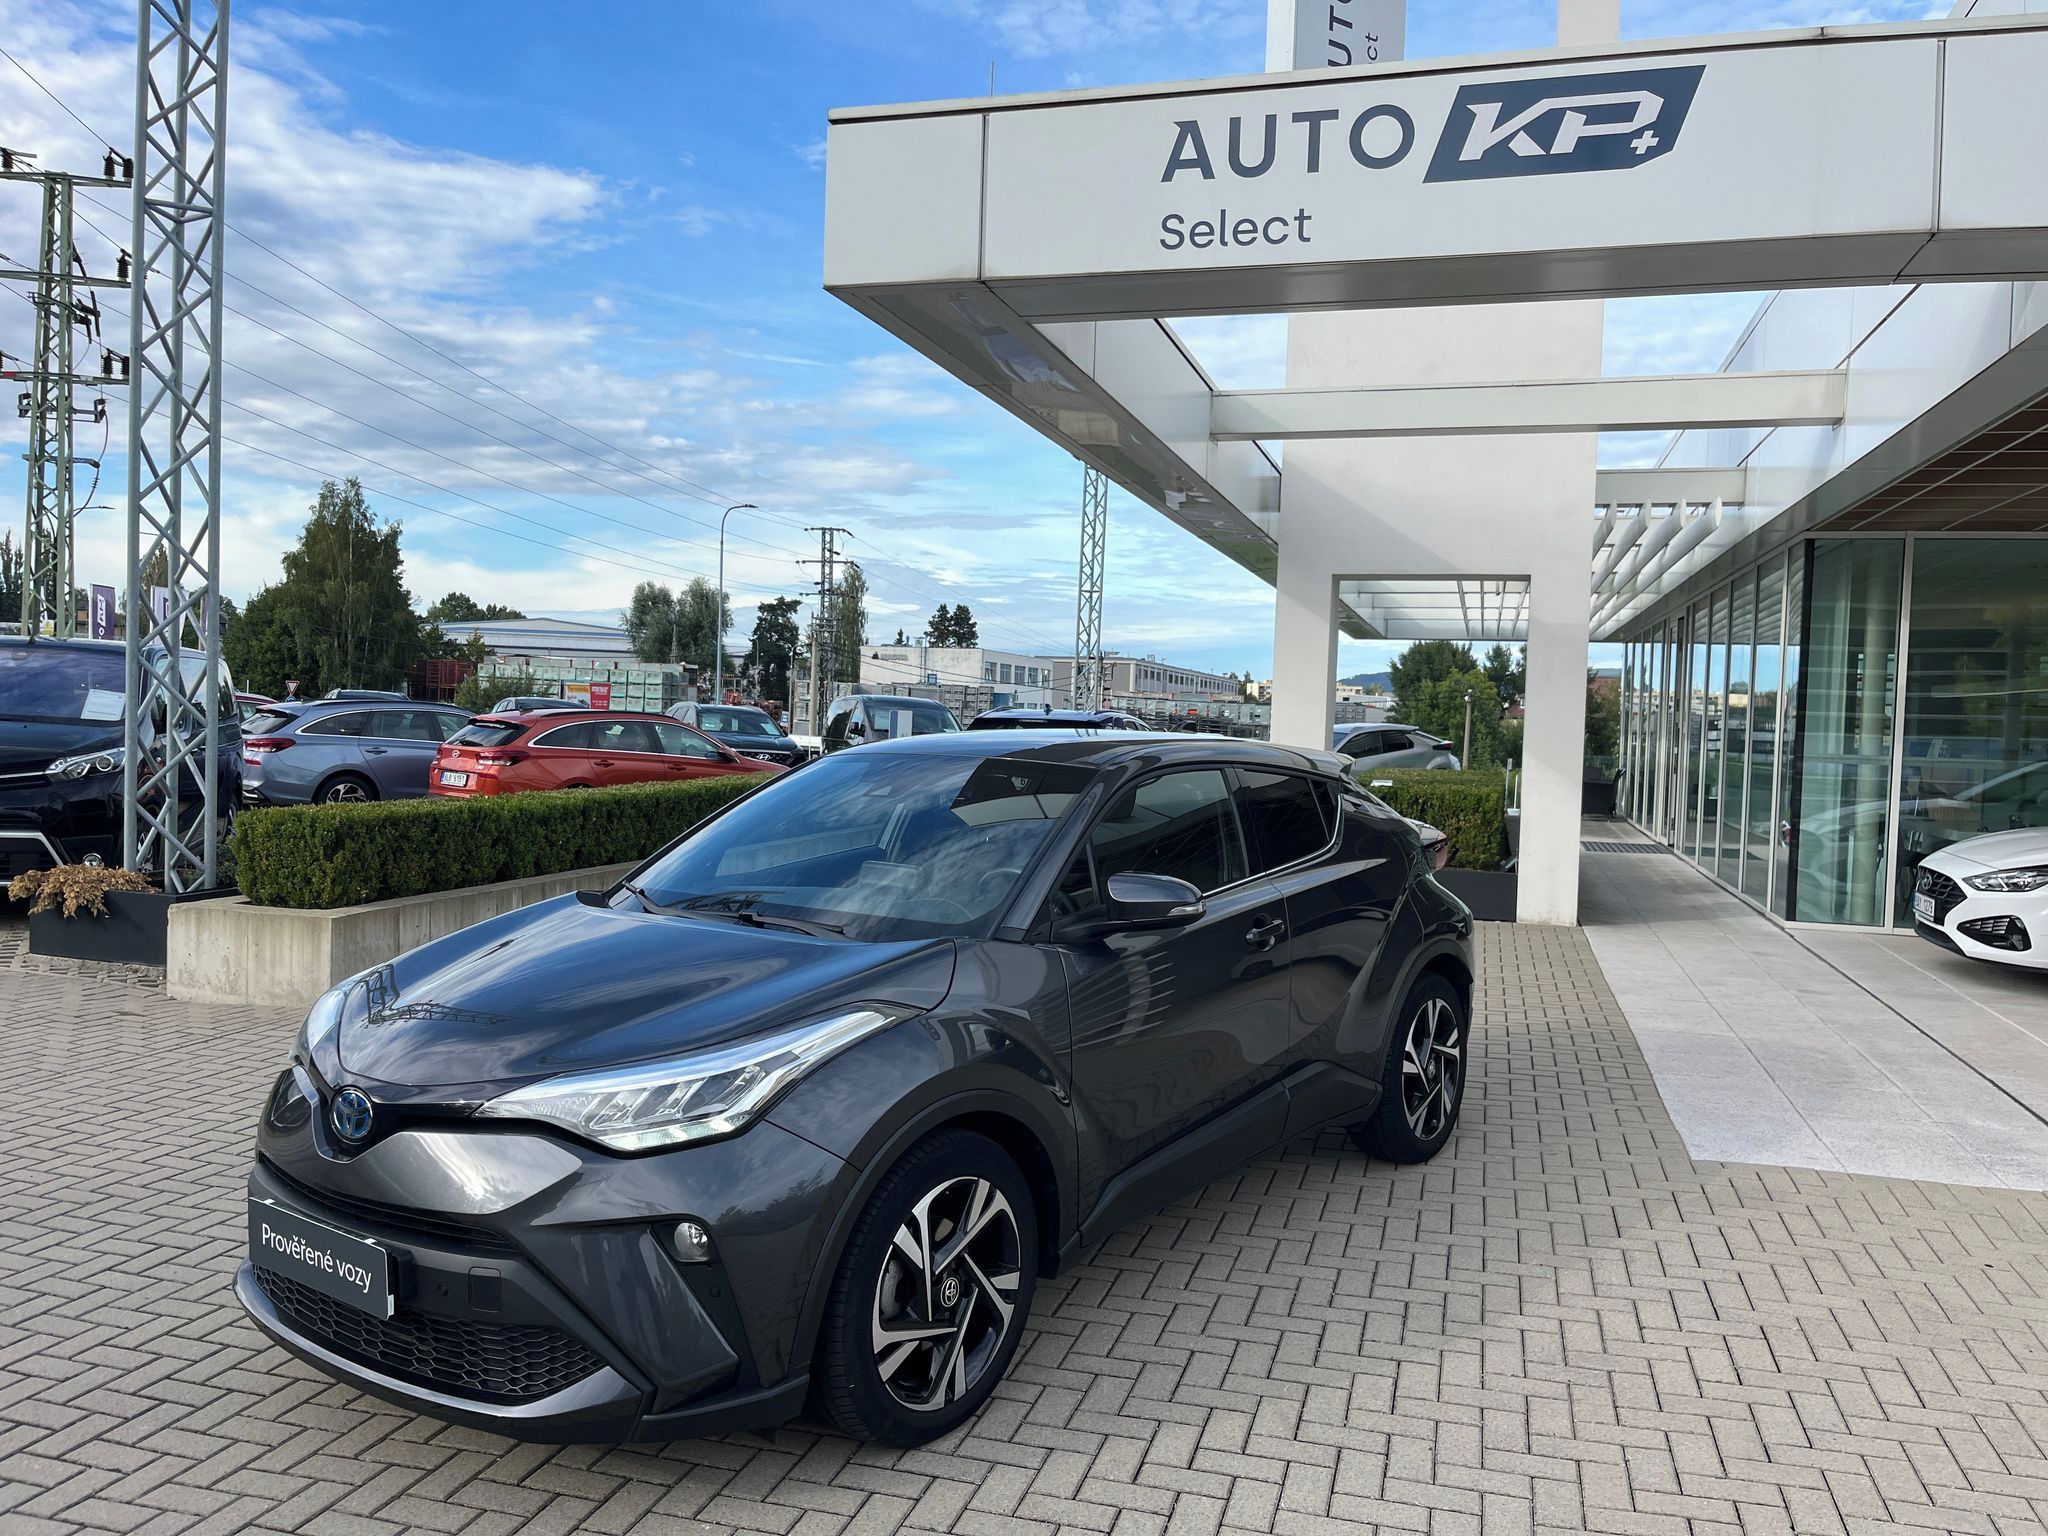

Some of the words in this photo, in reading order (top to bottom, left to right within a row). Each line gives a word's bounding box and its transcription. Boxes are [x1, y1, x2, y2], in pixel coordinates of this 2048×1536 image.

[1327, 0, 1353, 67] UT
[1160, 103, 1416, 184] AUTO
[1159, 207, 1312, 251] Select
[262, 1223, 333, 1273] Prověřené
[336, 1259, 372, 1293] vozy
